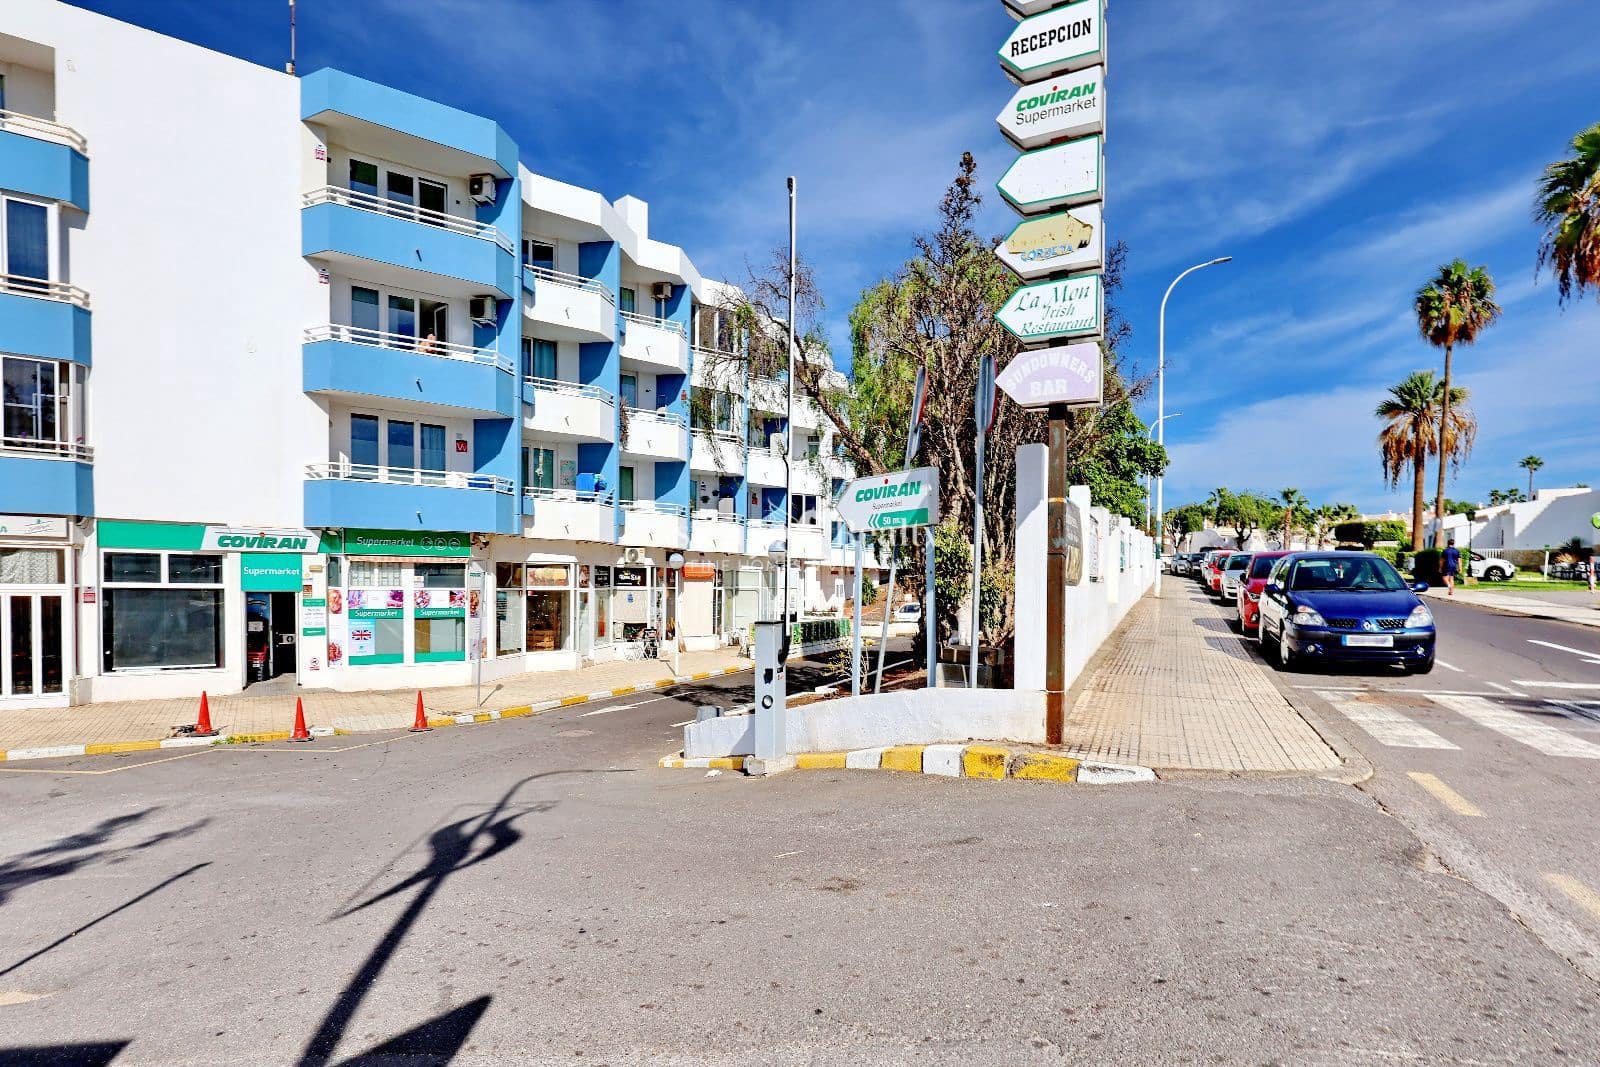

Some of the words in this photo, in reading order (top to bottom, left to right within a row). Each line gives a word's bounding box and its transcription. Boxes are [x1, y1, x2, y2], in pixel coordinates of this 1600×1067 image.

[1010, 18, 1092, 58] RECEPCION
[1015, 96, 1097, 125] Supermarket
[1014, 291, 1040, 312] La
[1052, 284, 1090, 303] Mon
[1041, 303, 1076, 320] Irish
[1019, 316, 1095, 335] Restaurant
[1006, 352, 1096, 391] SUNDOWNERS
[1030, 379, 1068, 396] BAR
[855, 479, 922, 503] COVIRAN
[217, 532, 308, 550] COVIRAN
[356, 536, 414, 547] Supermarket
[243, 565, 300, 576] Supermarket
[354, 610, 398, 618] Supermarket
[419, 609, 460, 617] Supermarket
